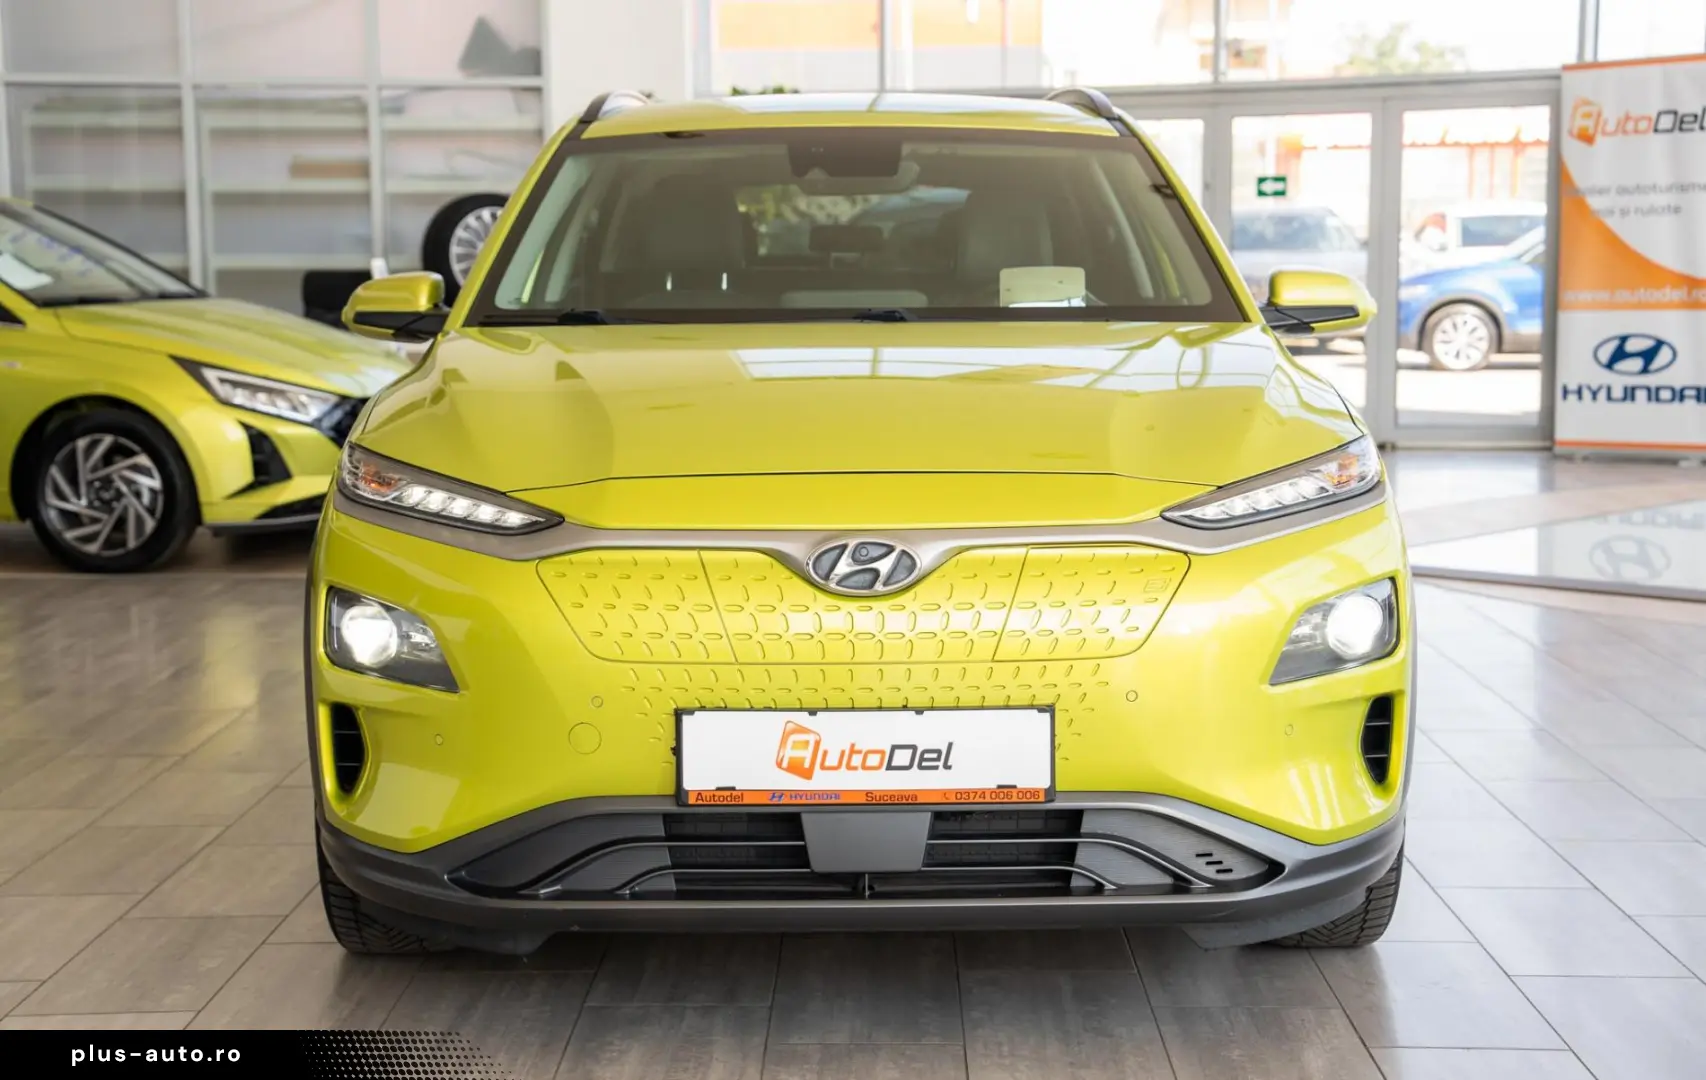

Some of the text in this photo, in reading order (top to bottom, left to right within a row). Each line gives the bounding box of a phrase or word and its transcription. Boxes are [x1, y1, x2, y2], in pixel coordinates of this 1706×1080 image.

[776, 720, 953, 780] AutoDel
[695, 789, 1040, 803] Autodel HYUNDAI Suceava 0374 006 006
